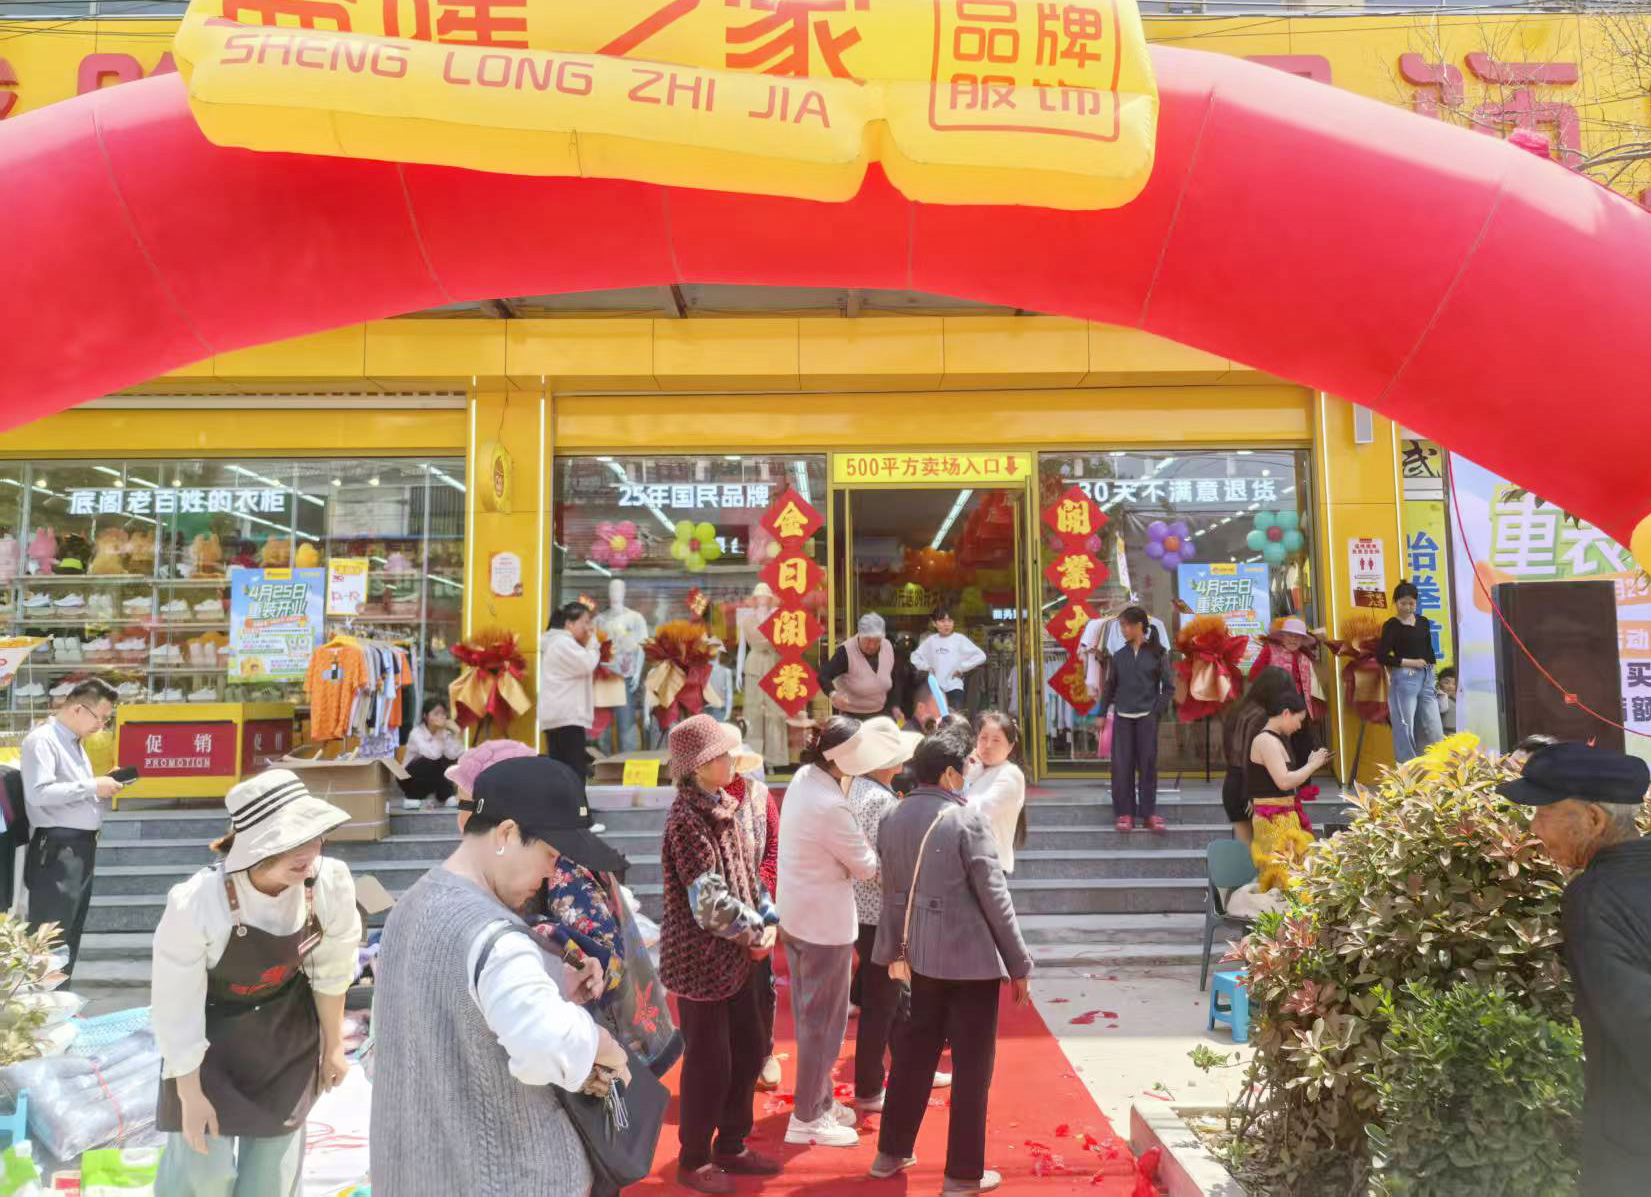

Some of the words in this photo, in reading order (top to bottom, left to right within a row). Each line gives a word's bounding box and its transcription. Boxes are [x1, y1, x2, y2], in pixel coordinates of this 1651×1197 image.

[951, 0, 1103, 69] 品牌
[219, 33, 411, 79] SHENG
[442, 51, 595, 97] LONG
[628, 67, 716, 112] ZHI
[748, 84, 831, 129] JIA
[948, 72, 1103, 117] 服饰
[847, 456, 1000, 477] 500平方卖场入口
[618, 485, 769, 508] 25年国民品牌
[1196, 579, 1252, 595] 4月25日
[145, 733, 212, 754] 促销
[144, 757, 211, 768] PROMOTION
